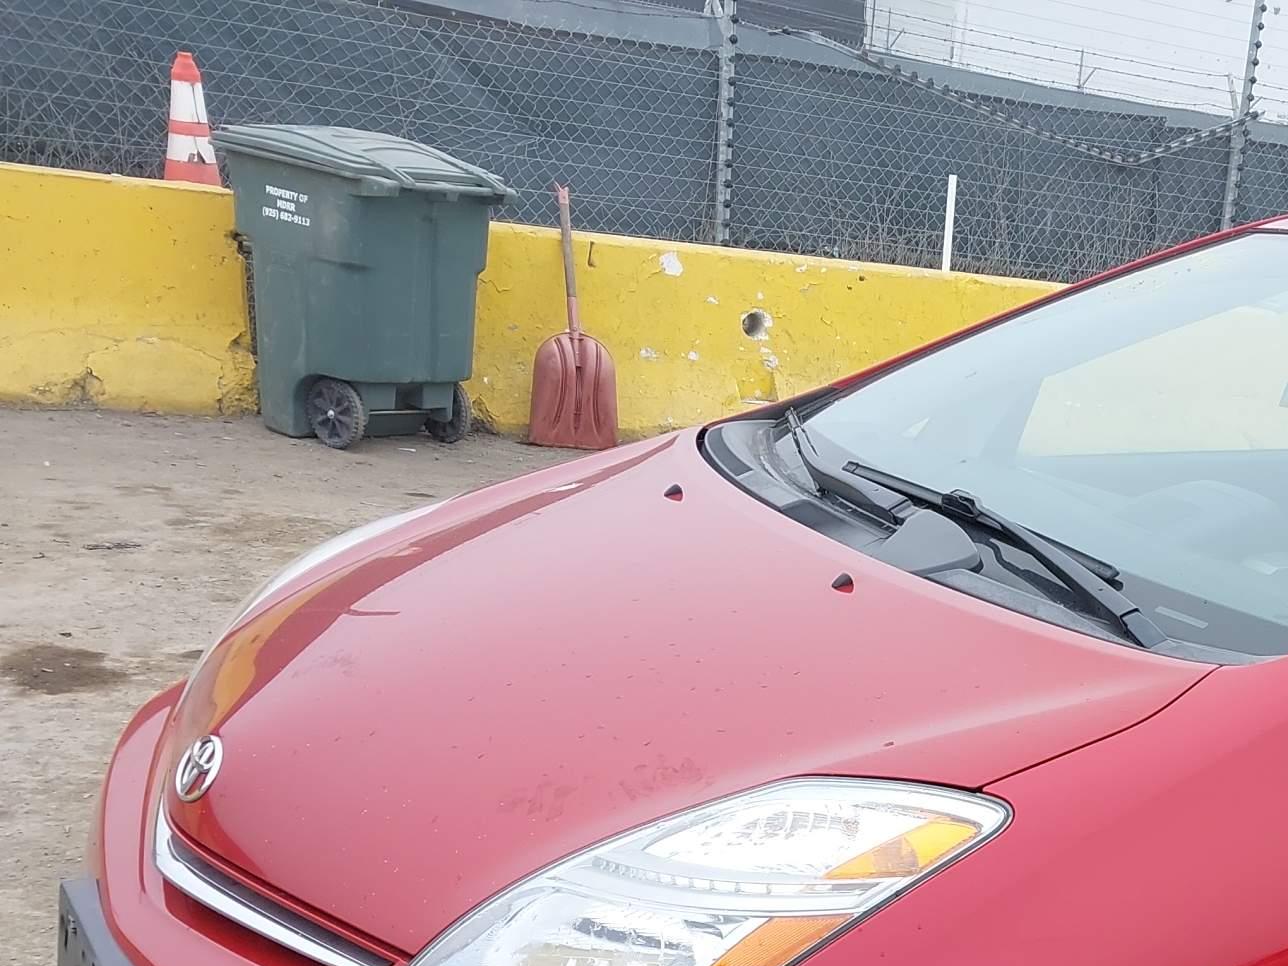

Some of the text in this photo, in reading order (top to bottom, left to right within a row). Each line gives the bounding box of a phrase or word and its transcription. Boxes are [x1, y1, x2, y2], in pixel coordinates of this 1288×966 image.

[265, 184, 308, 203] PROPERTY OF
[262, 206, 279, 220] (925)
